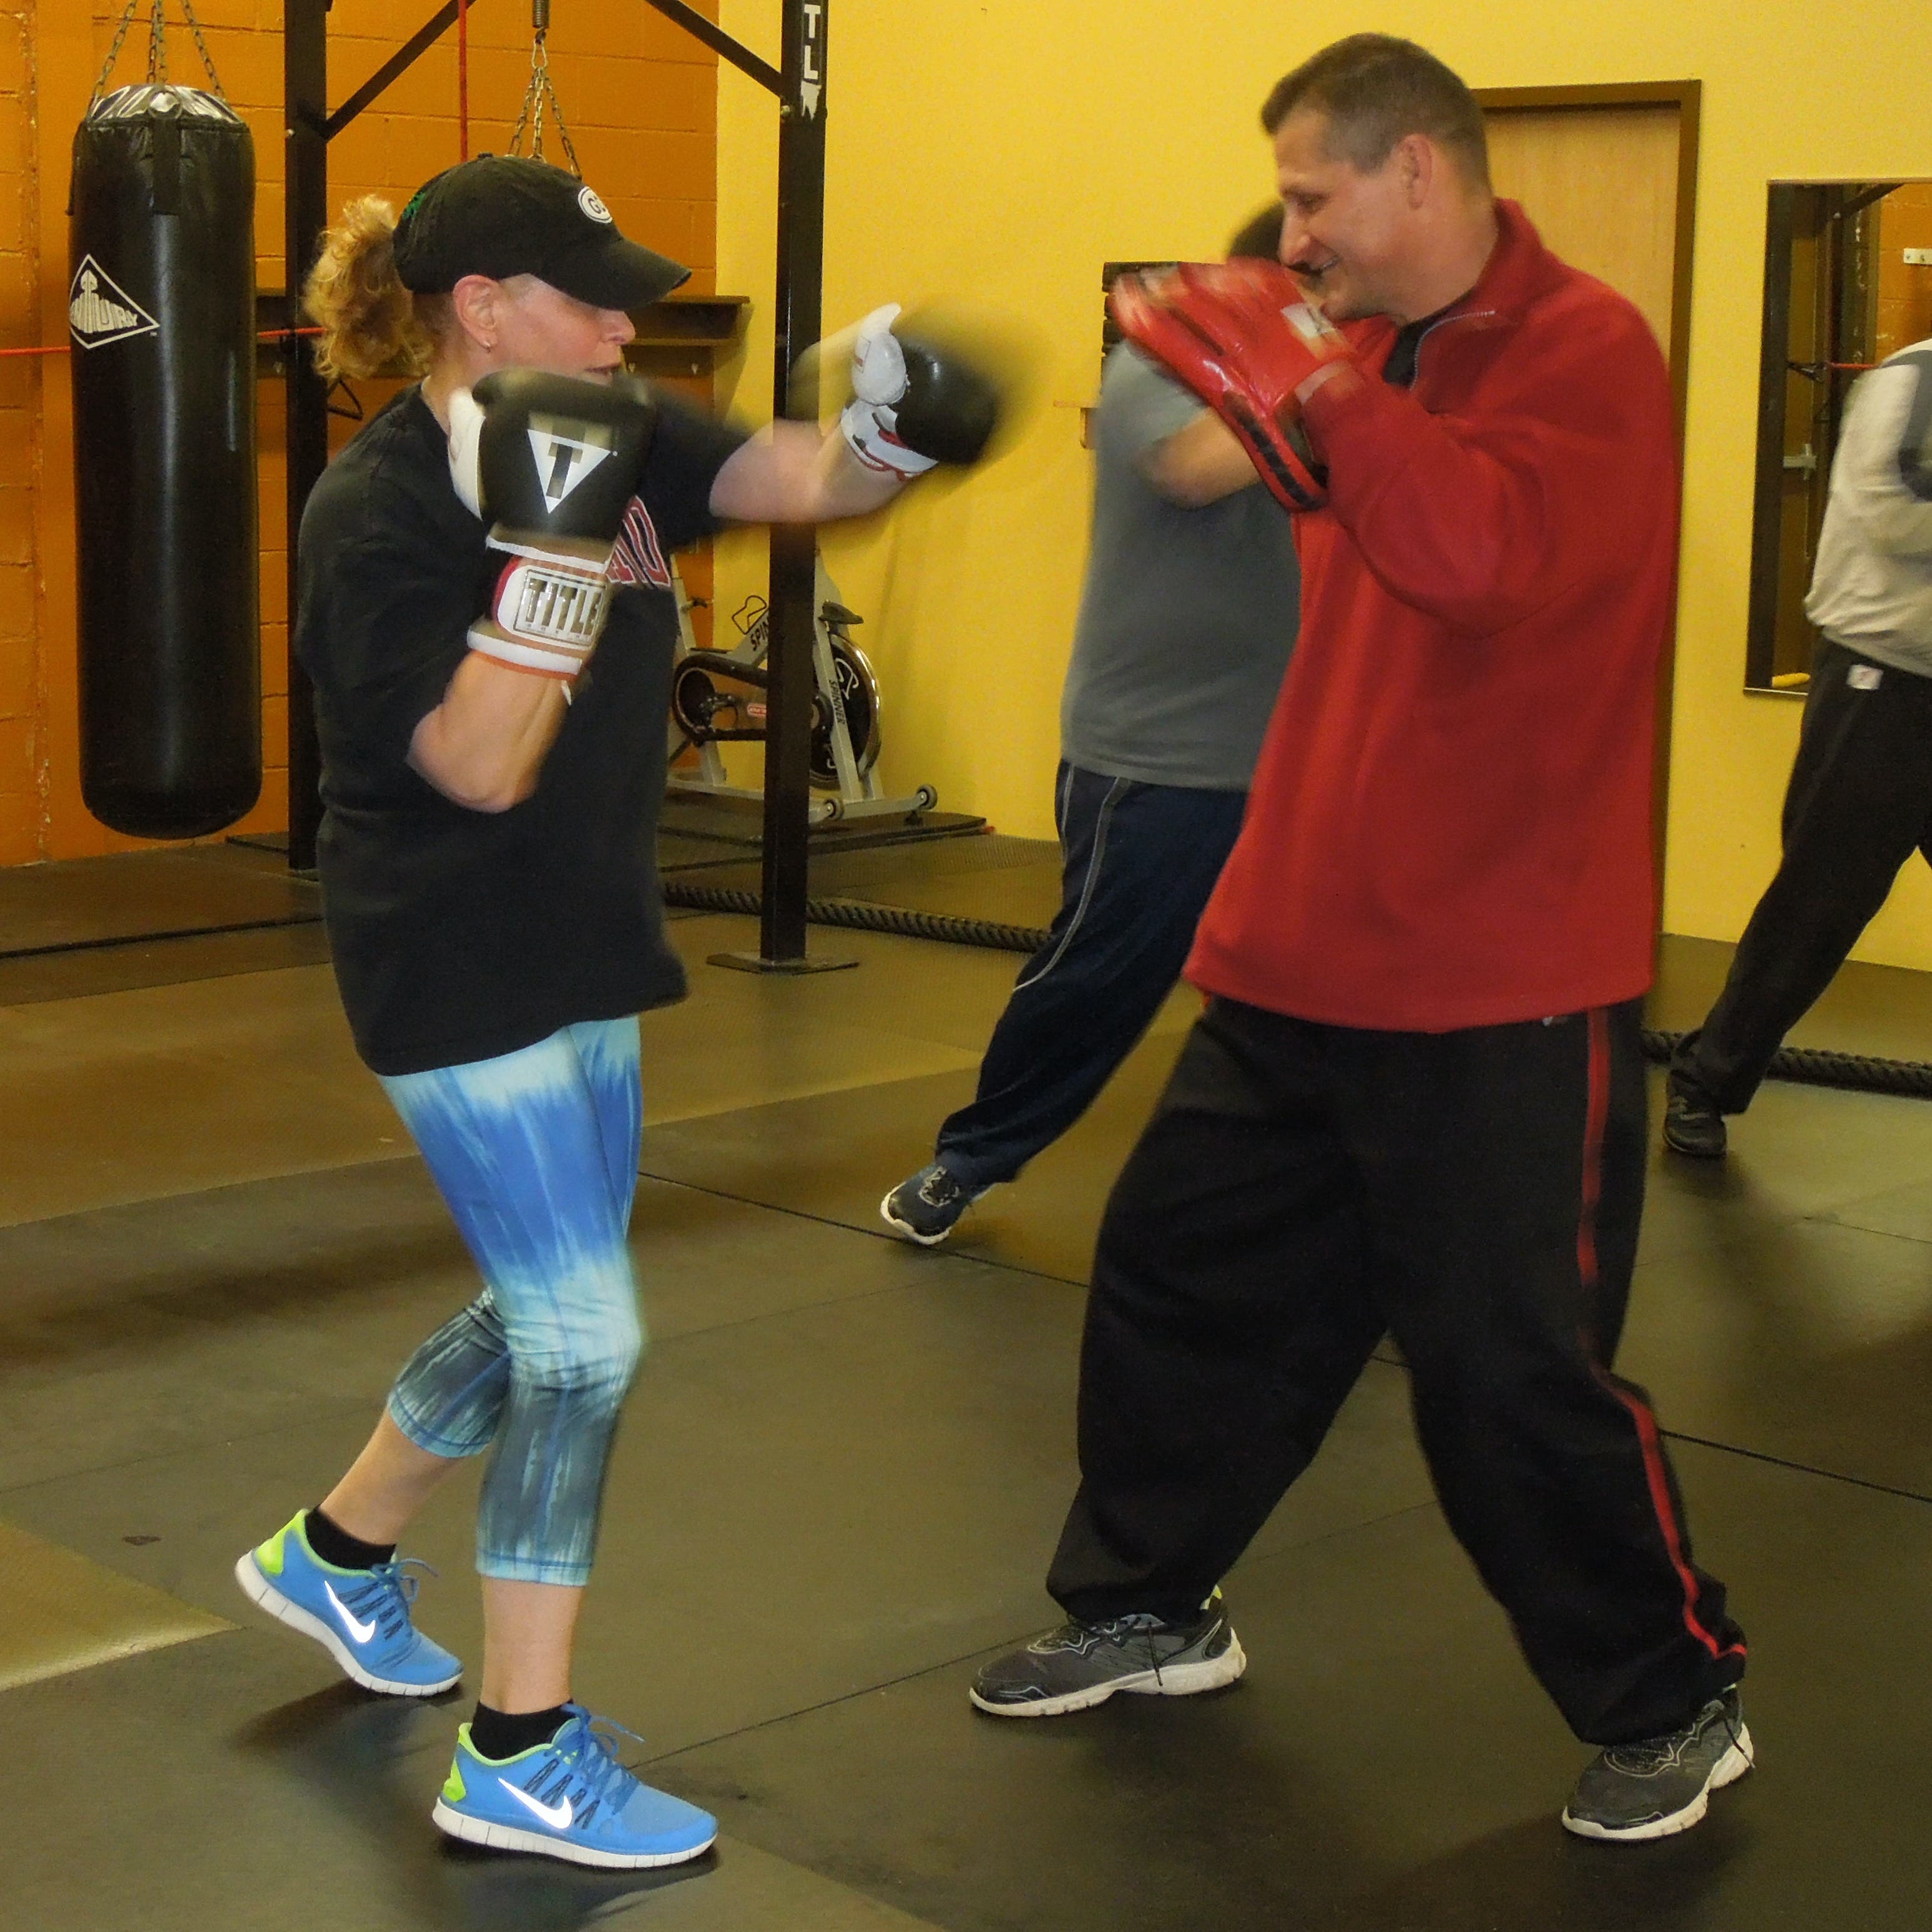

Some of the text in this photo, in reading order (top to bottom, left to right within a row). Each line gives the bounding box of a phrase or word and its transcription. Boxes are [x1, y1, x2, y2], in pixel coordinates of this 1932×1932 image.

[546, 441, 584, 500] T
[525, 577, 602, 635] TITLE
[828, 678, 846, 725] SPINNER
